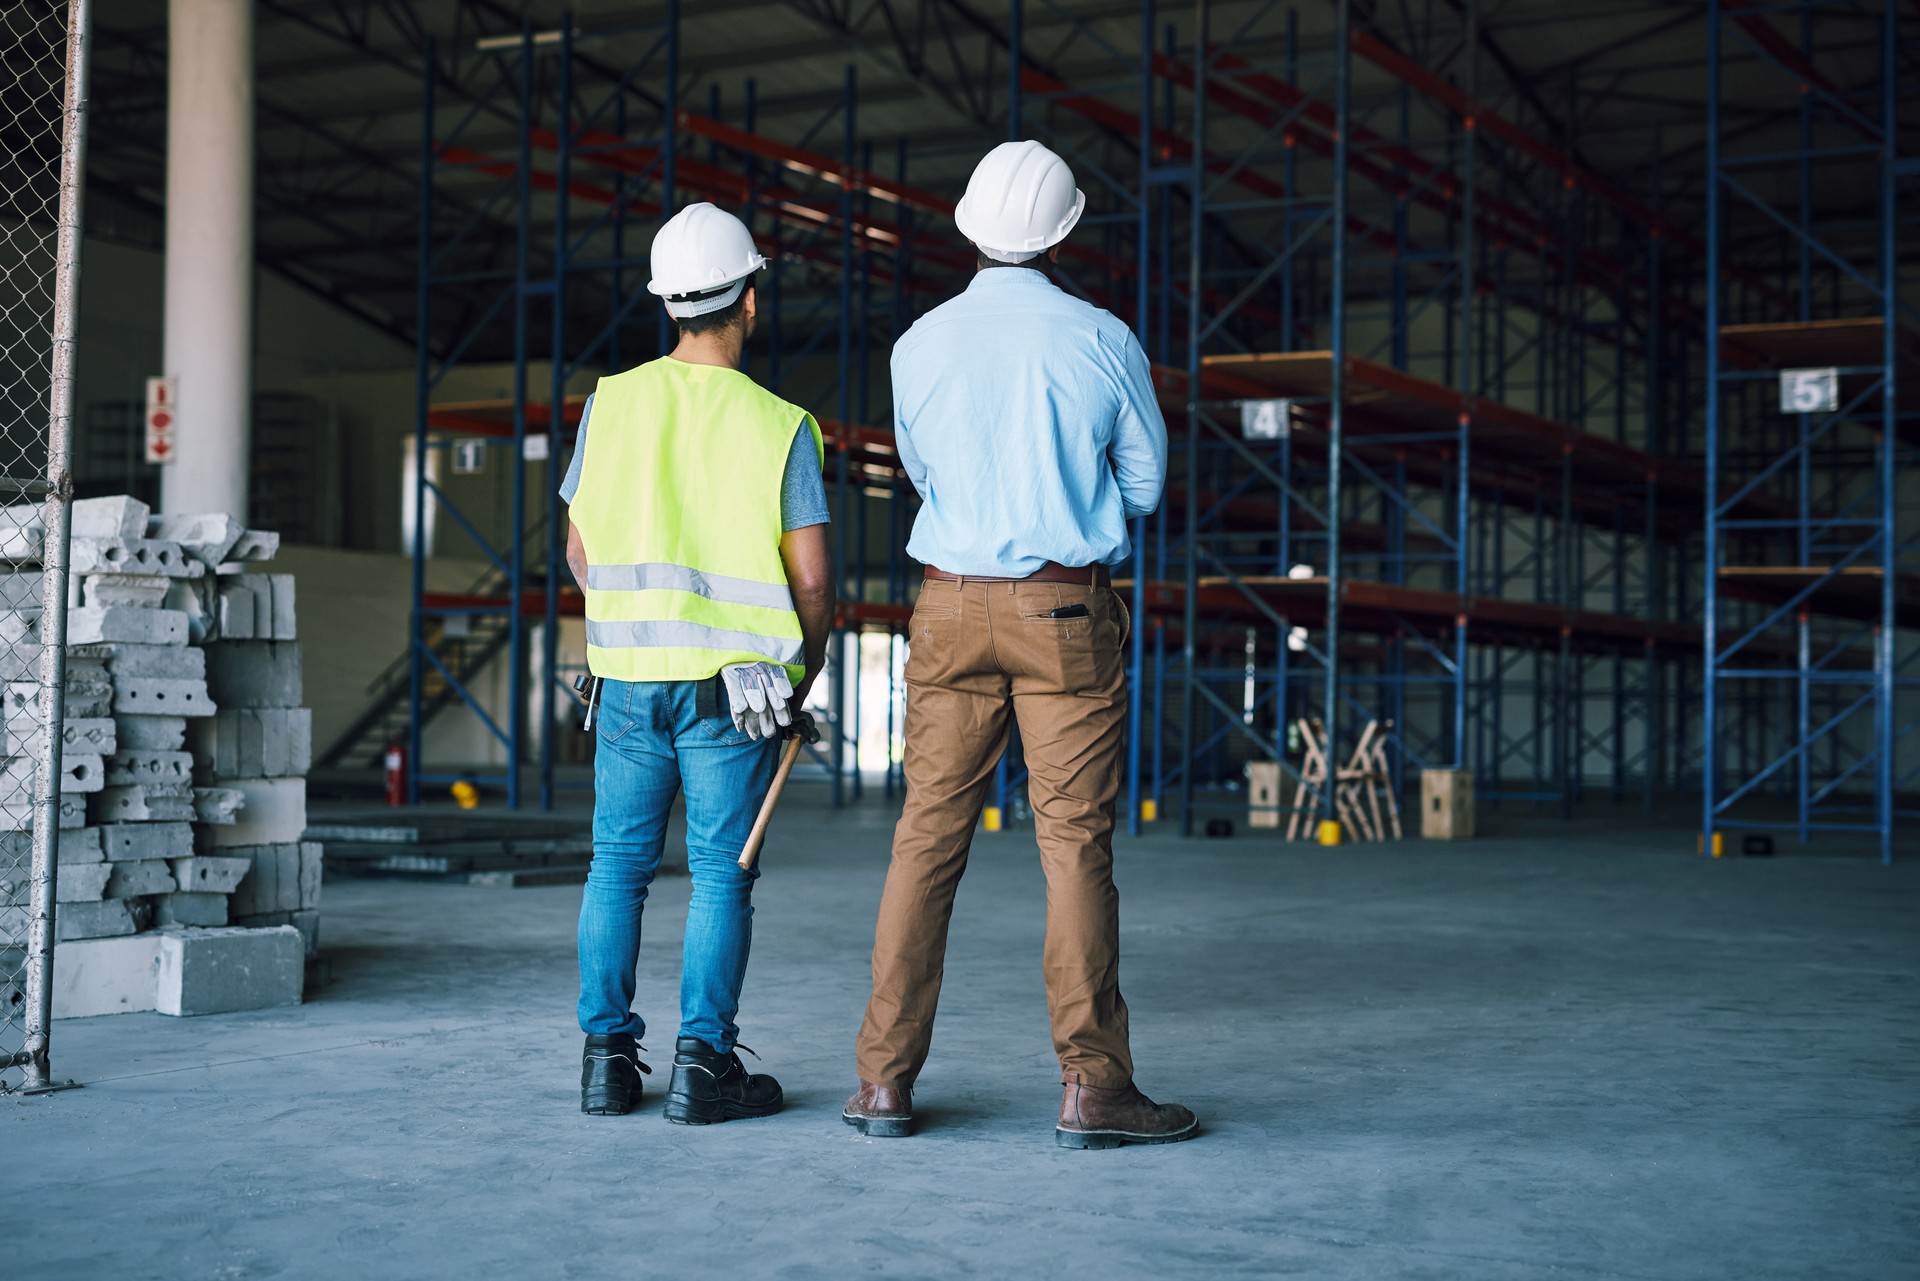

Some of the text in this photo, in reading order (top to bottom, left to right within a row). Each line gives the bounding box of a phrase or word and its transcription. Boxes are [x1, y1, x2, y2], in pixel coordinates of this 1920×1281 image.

[1793, 373, 1822, 412] 5
[1254, 401, 1279, 438] 4
[462, 441, 475, 473] 1
